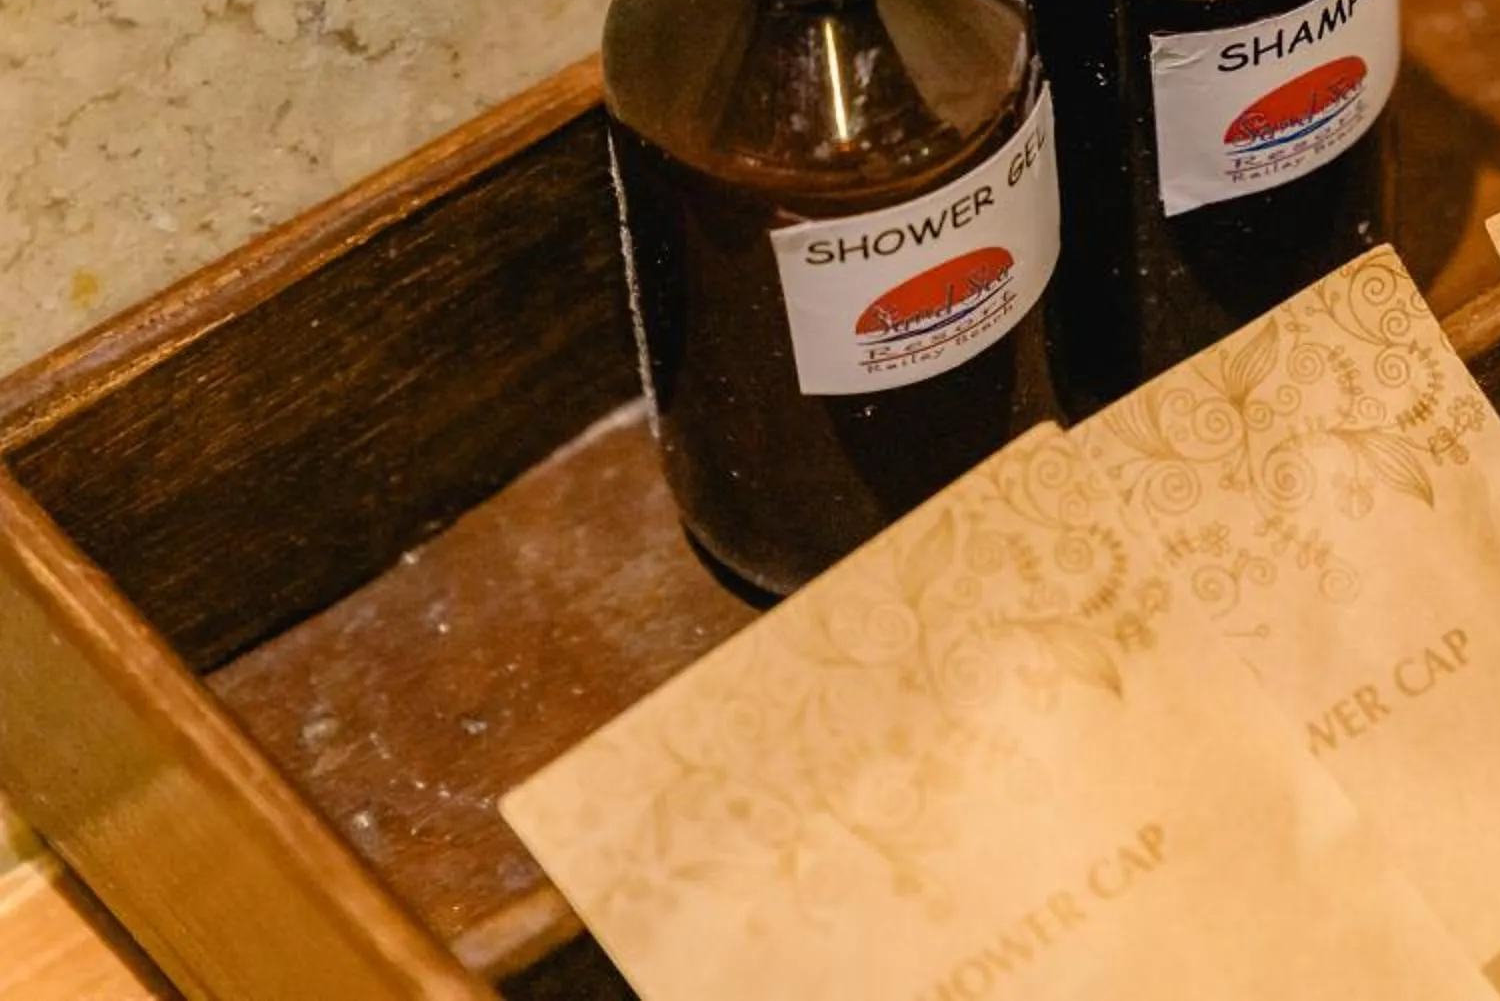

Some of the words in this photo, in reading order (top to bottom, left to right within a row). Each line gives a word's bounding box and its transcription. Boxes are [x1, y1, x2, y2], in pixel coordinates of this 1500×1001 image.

[805, 185, 995, 265] SHOWER
[1007, 125, 1047, 187] GEL
[1305, 684, 1393, 757] WER
[1393, 627, 1469, 697] CAP
[914, 890, 1087, 1001] OWER
[1086, 822, 1166, 900] CAP
